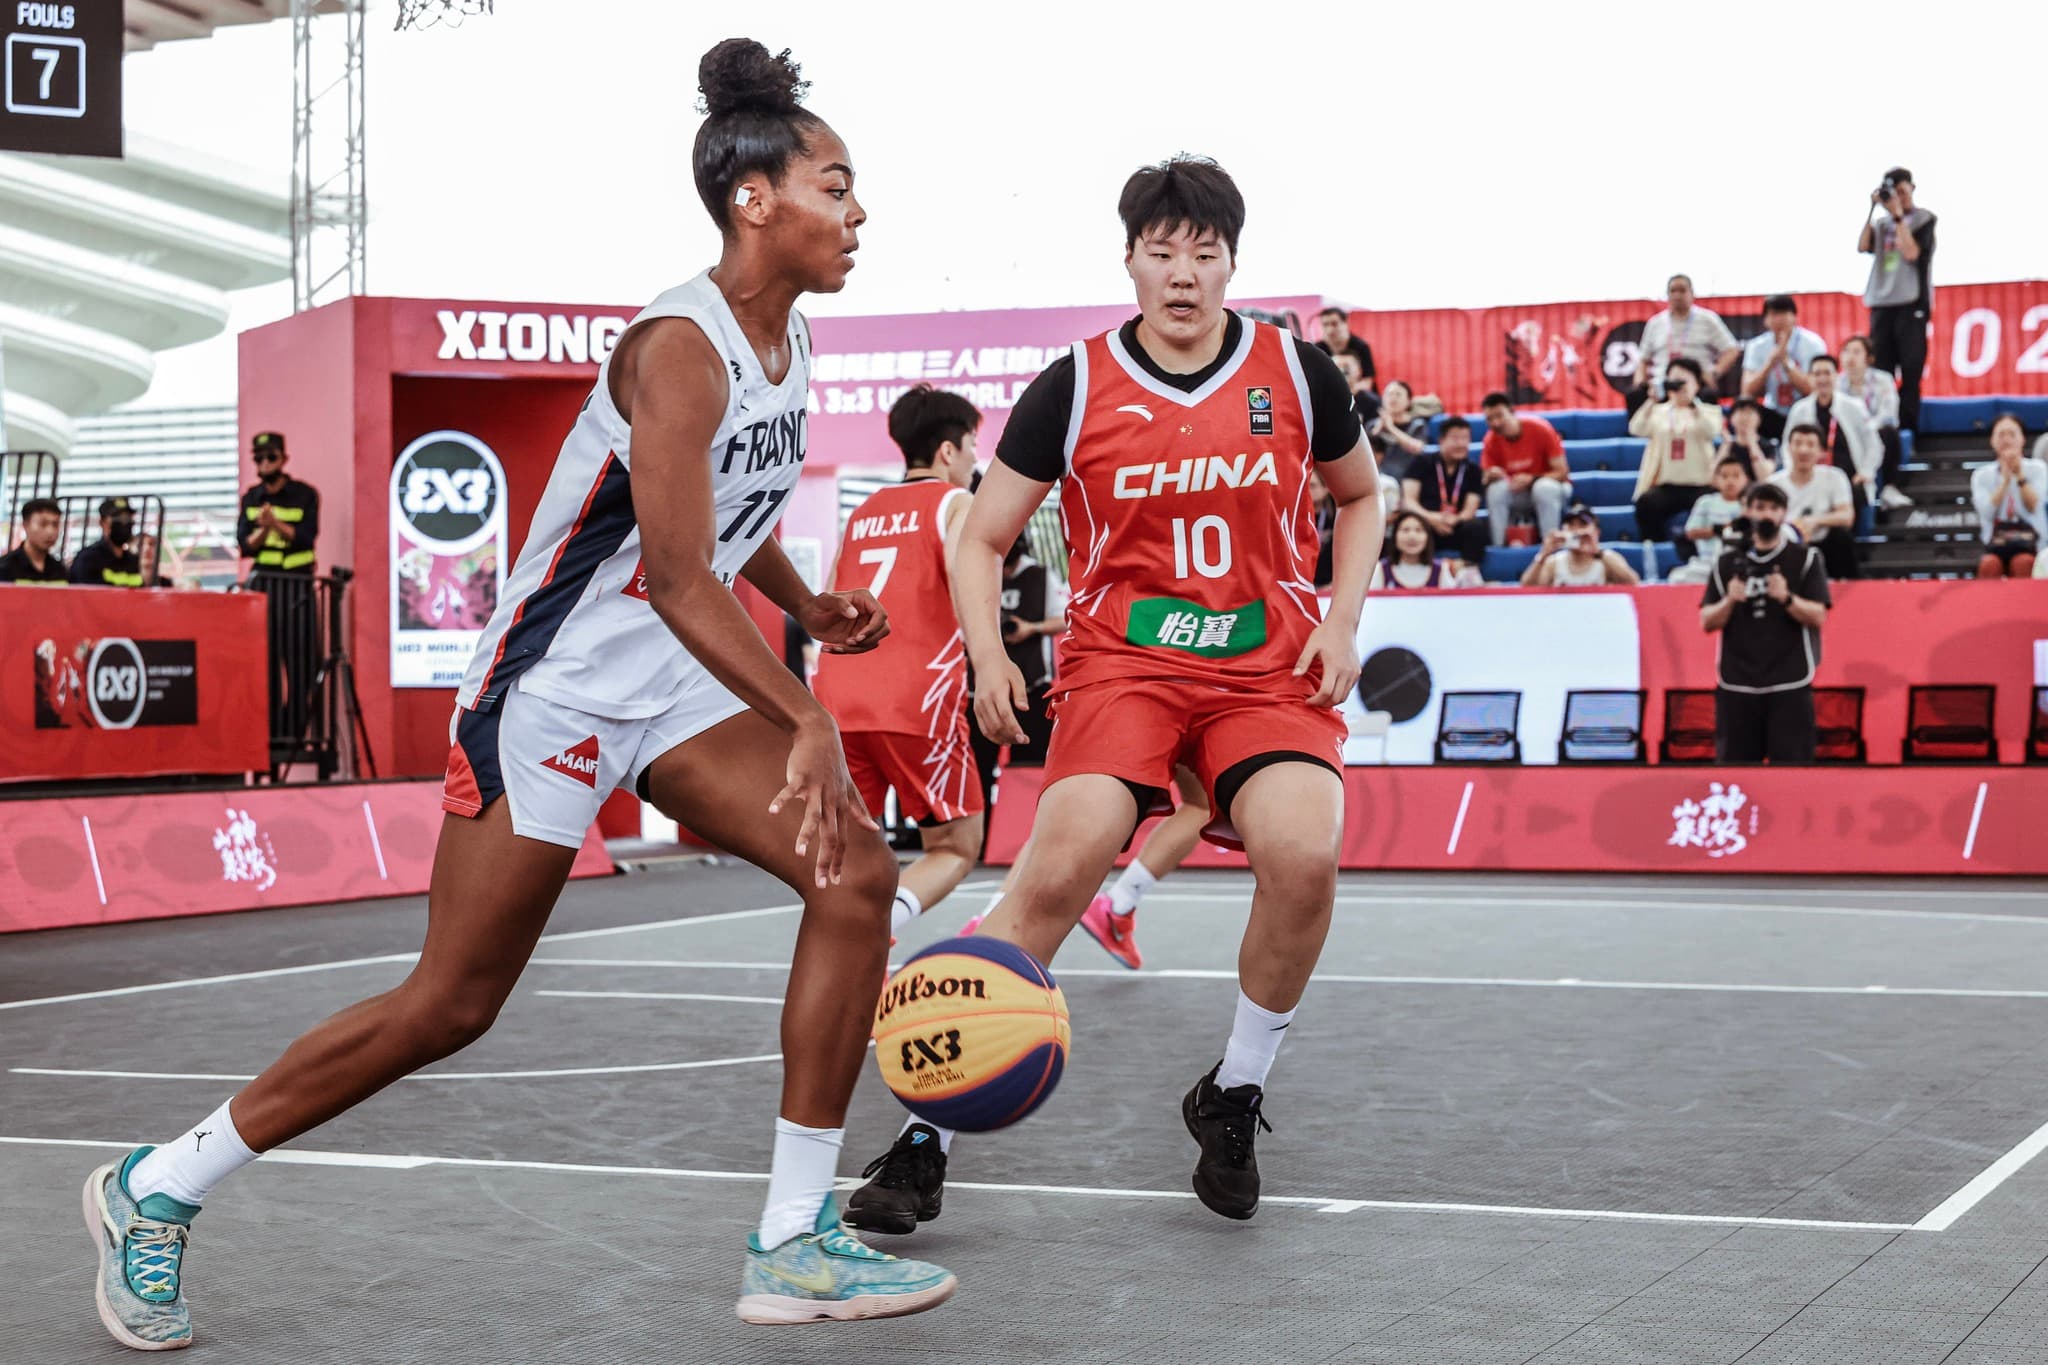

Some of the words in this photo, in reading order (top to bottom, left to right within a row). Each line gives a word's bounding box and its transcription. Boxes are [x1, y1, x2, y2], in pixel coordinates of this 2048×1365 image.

[17, 2, 75, 29] FOULS
[32, 48, 60, 99] 7
[437, 310, 628, 364] XIONG
[1924, 304, 2048, 378] 02
[943, 381, 1029, 410] ORL
[1252, 414, 1269, 423] FIBA
[720, 408, 808, 474] FRANC
[1113, 452, 1279, 500] CHINA
[852, 511, 919, 541] WU.X.L
[1172, 515, 1232, 579] 10
[859, 546, 898, 601] 7
[1157, 611, 1237, 648] 怡寶
[555, 752, 599, 774] MAIF
[879, 973, 986, 1021] Wilson
